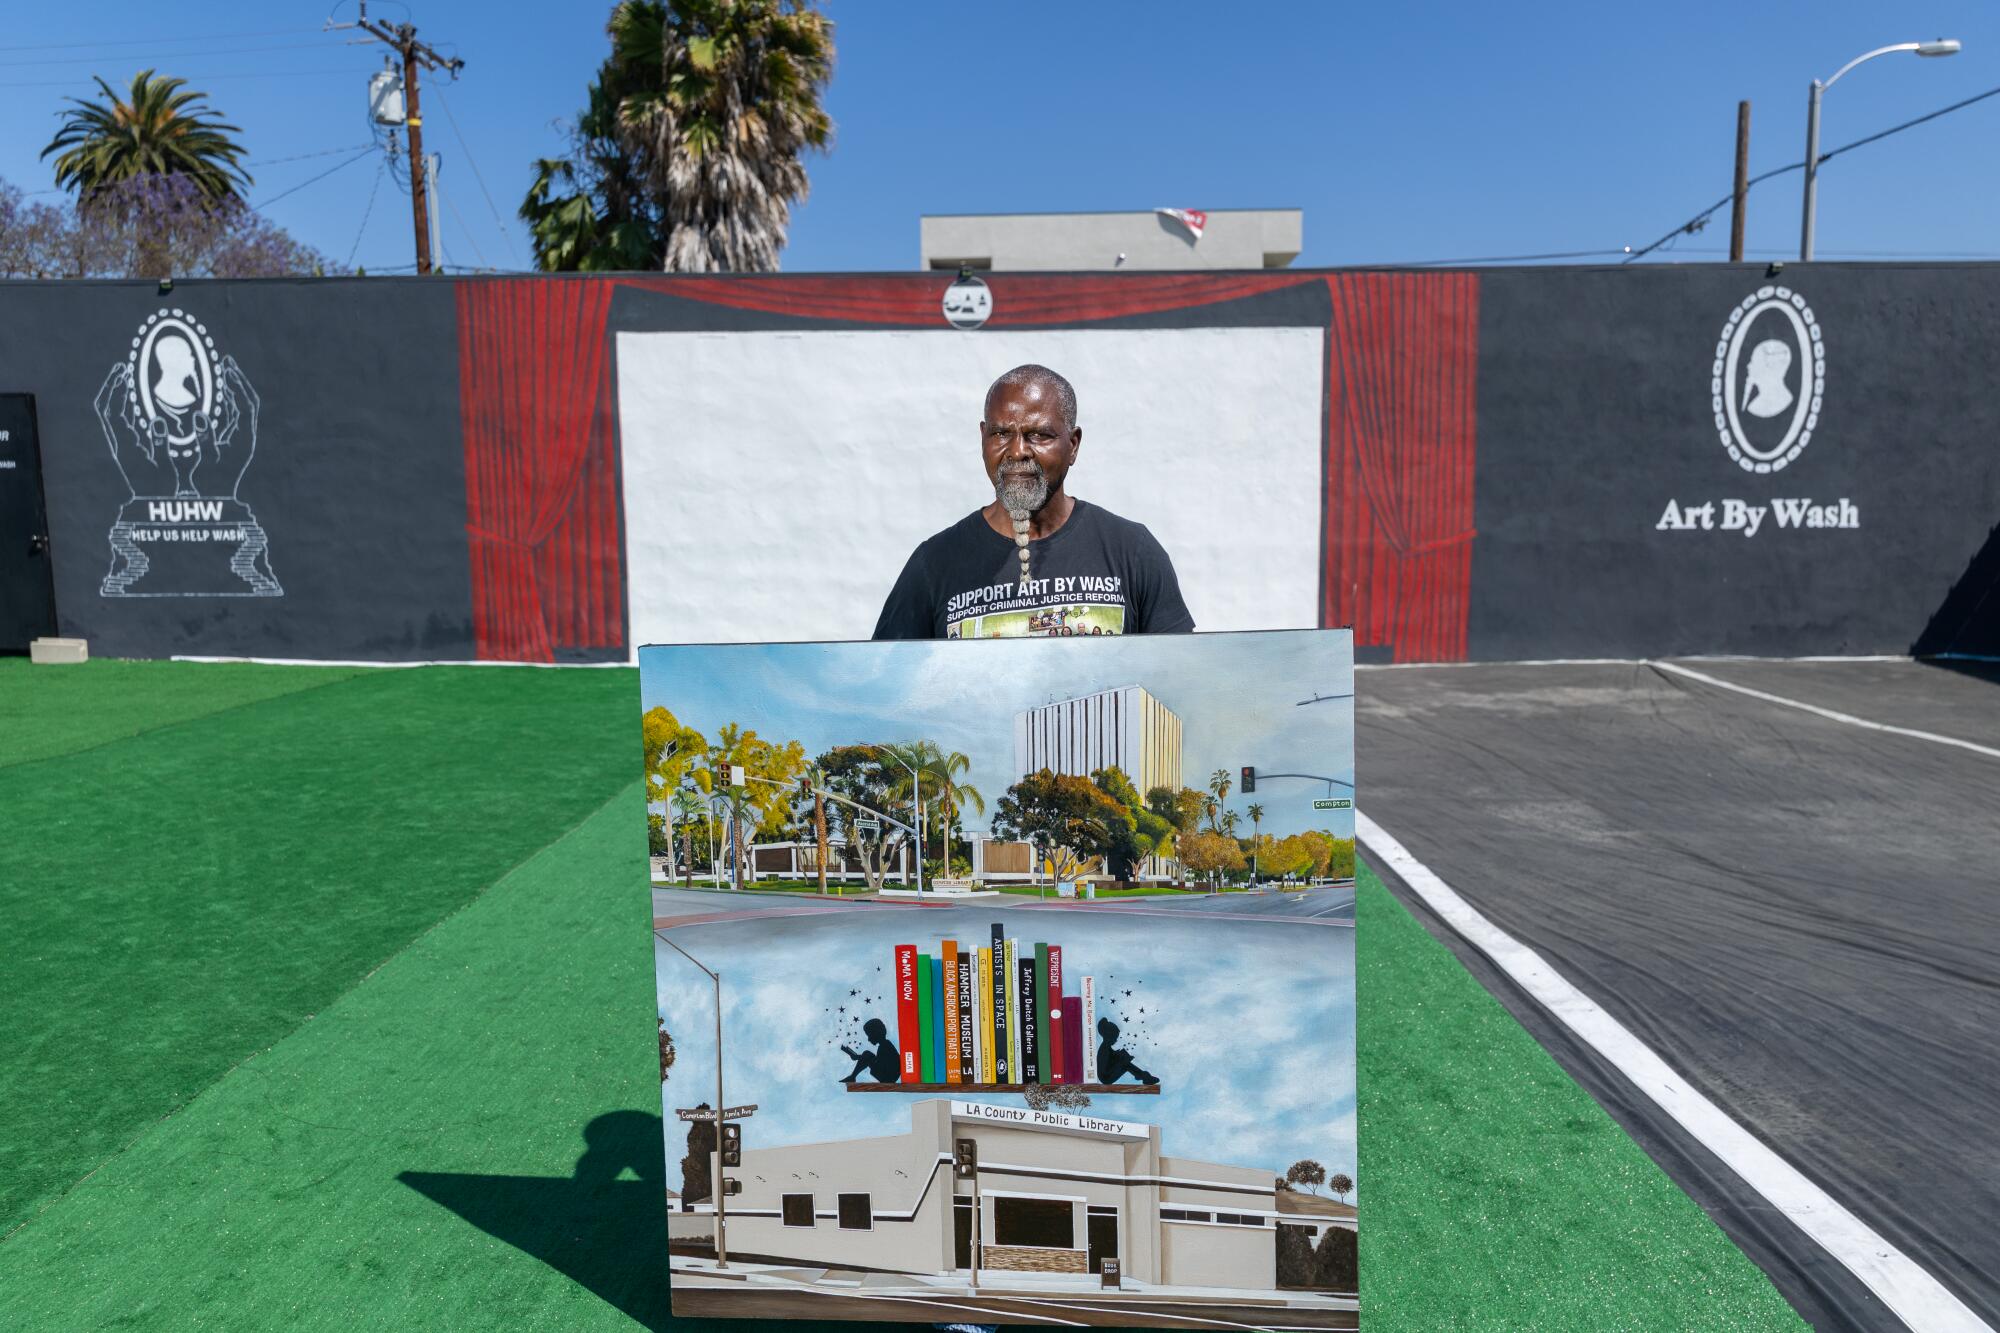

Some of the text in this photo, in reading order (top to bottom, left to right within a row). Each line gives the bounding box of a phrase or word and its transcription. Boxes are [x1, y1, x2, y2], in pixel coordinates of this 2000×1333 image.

[148, 501, 223, 522] HUHW
[1655, 498, 1860, 538] Art By Wash
[132, 529, 247, 541] HELP US HELP WASH
[947, 582, 1013, 612] SUPPORT
[1017, 579, 1050, 597] ART
[1054, 577, 1077, 593] BY
[947, 592, 1126, 622] SUPPORT CRIMINAL JUSTICE REFORM
[946, 960, 956, 982] BLACK
[994, 938, 1005, 1029] ARTISTS IN SPACE
[1050, 951, 1060, 988] WEPRESENT
[903, 980, 913, 1001] NOW
[946, 983, 957, 1018] AMERICAN
[959, 963, 972, 1058] HAMMER MUSEUM
[1022, 967, 1035, 1054] Jeffrey Deitch Galleries
[947, 1018, 958, 1059] PORTRAITS
[963, 1066, 973, 1075] LA
[966, 1104, 1124, 1133] LA County Public Library
